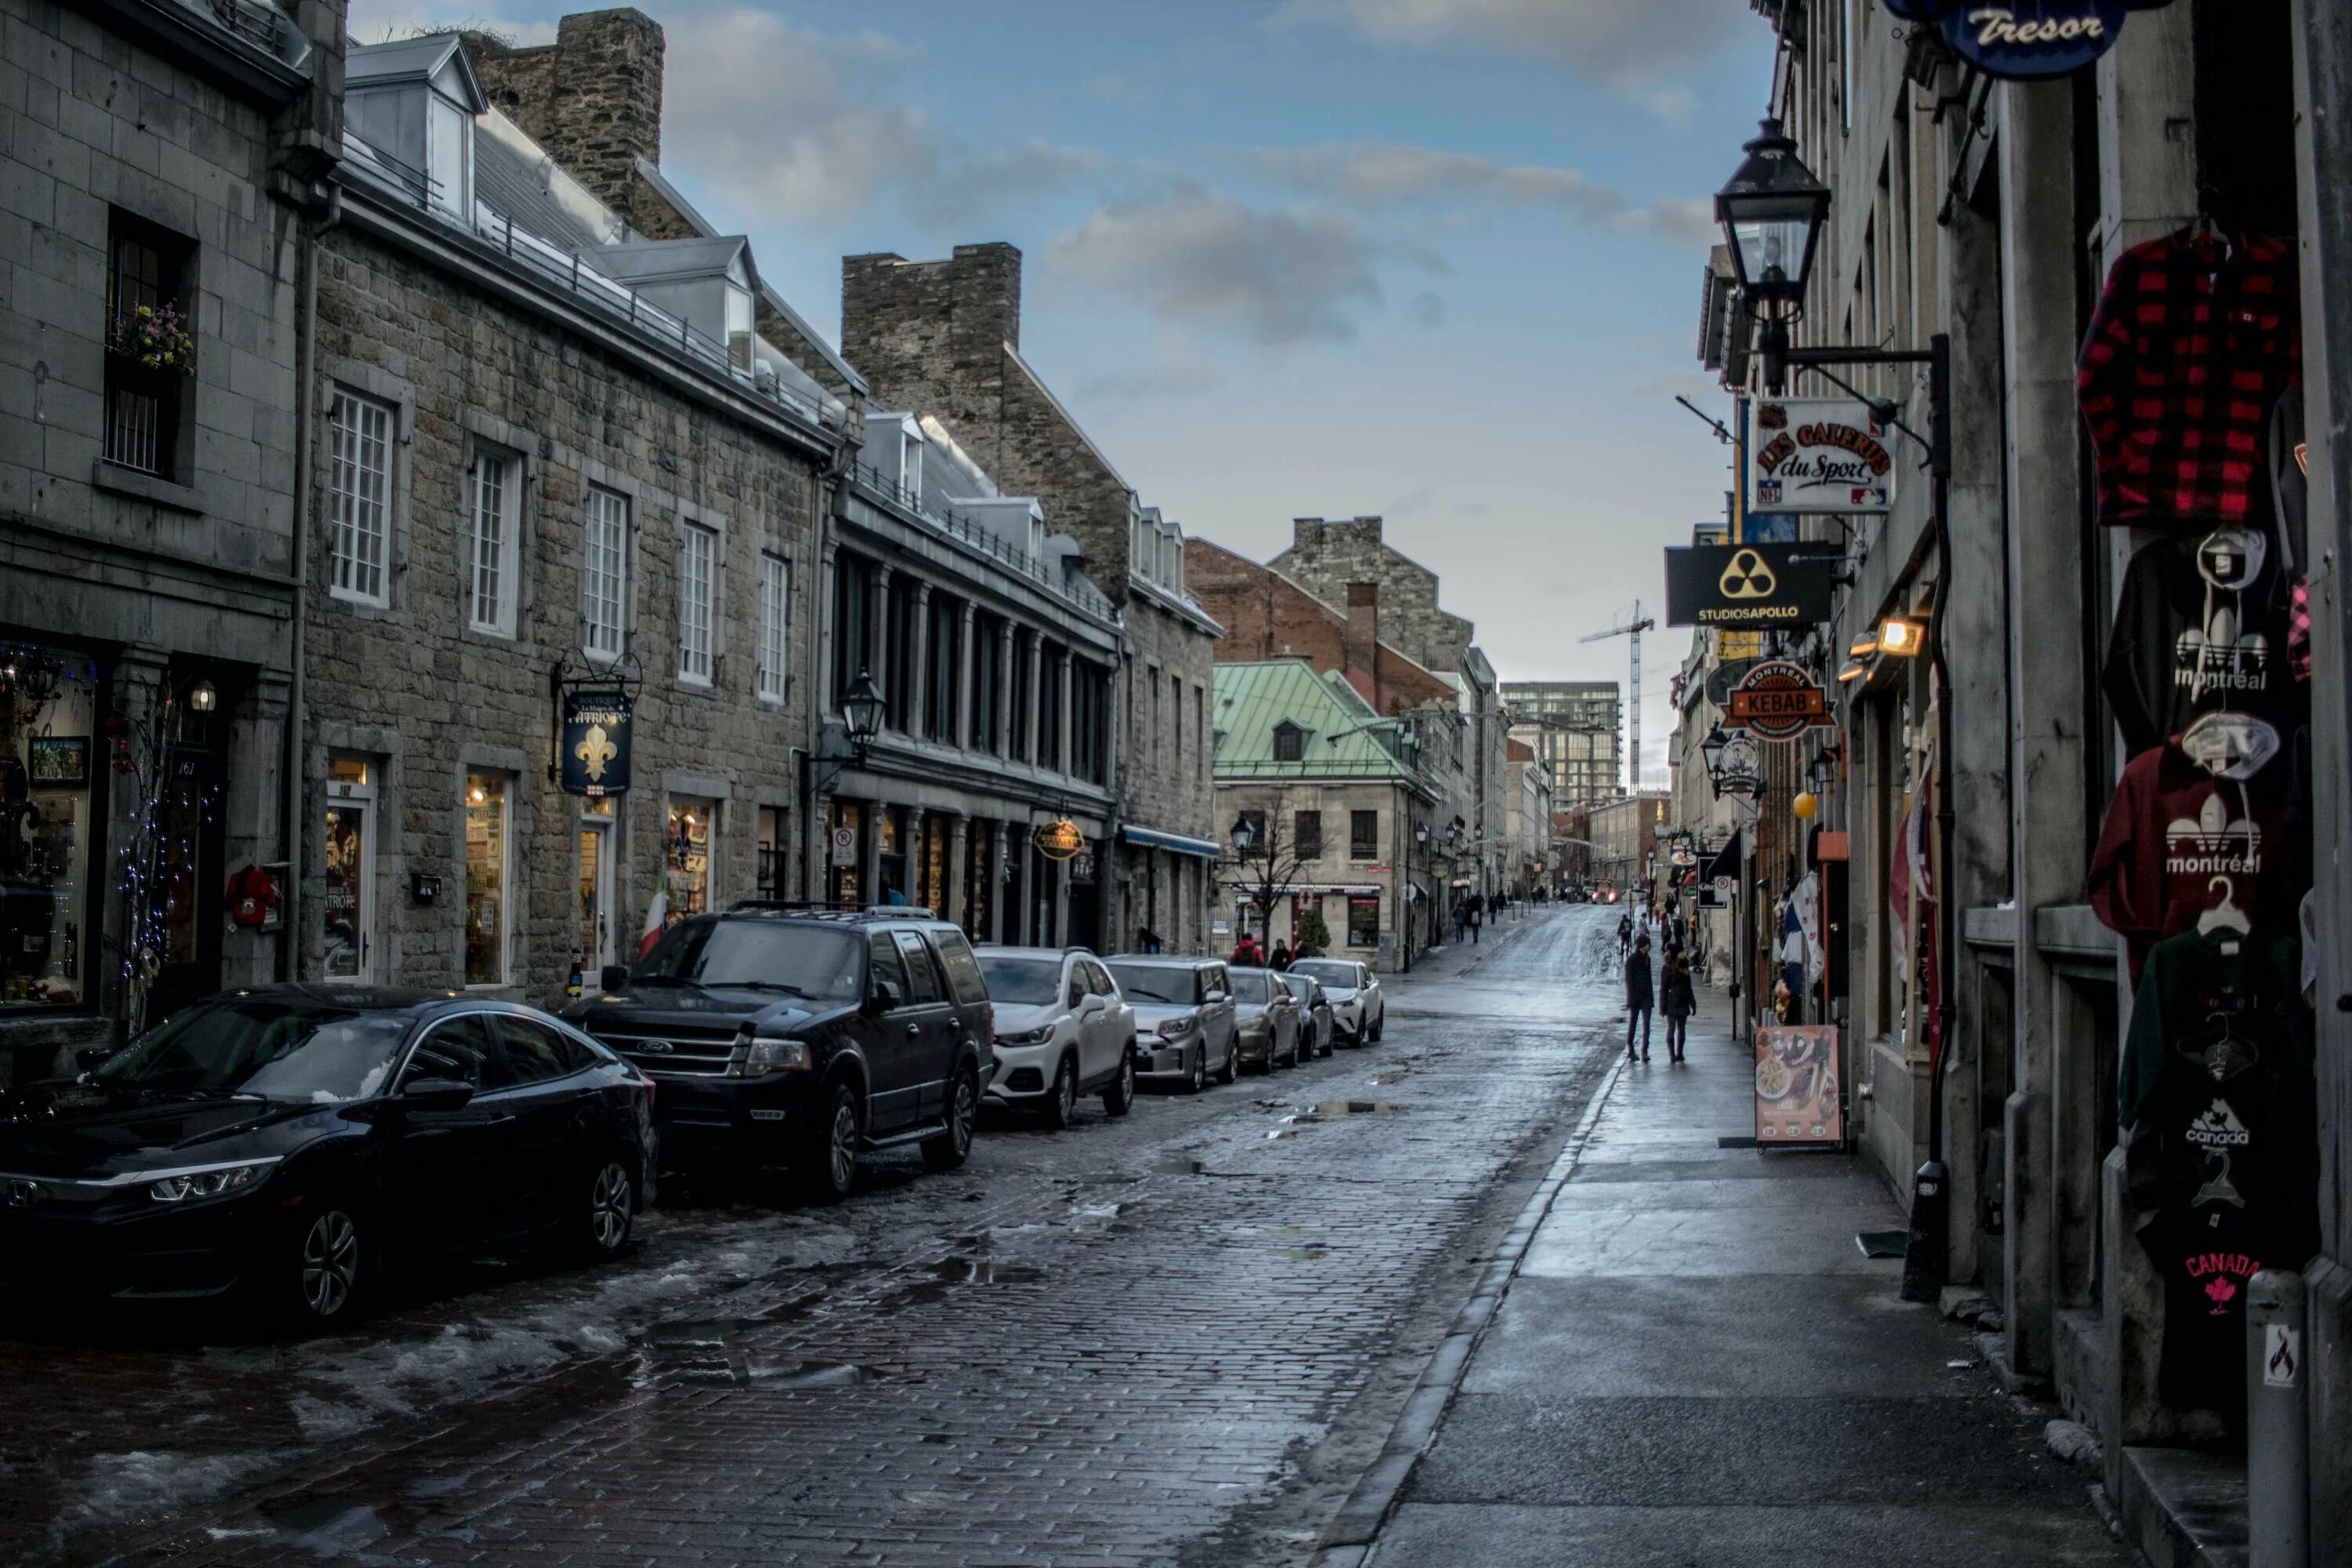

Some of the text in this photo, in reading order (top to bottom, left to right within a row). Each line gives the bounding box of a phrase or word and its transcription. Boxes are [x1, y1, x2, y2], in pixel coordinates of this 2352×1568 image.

[1967, 7, 2104, 47] Tresor
[1757, 423, 1891, 476] LES GALERIES
[1780, 454, 1871, 485] du Sport
[2174, 666, 2267, 691] montréal
[1748, 693, 1807, 713] KEBAB
[568, 710, 626, 724] ATRIOTE
[179, 760, 194, 775] 161
[2165, 853, 2262, 874] montréal
[2186, 1130, 2249, 1145] canada
[2185, 1252, 2263, 1279] CANADA
